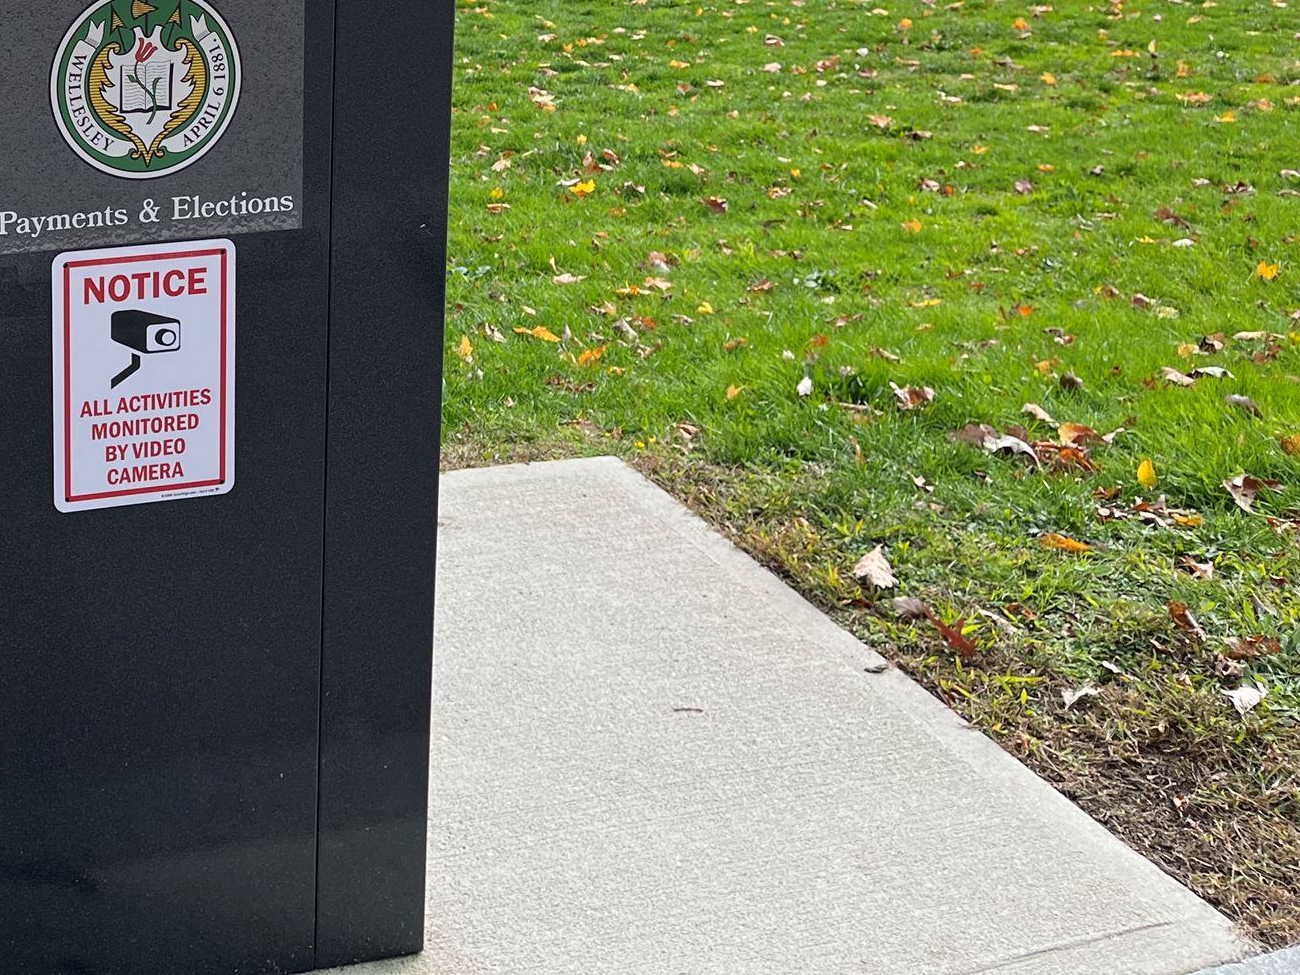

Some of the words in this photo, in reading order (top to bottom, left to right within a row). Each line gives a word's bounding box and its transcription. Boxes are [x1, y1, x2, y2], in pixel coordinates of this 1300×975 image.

[68, 54, 115, 152] WELLESLEY
[183, 101, 221, 148] APRIL
[213, 86, 225, 97] 6
[138, 198, 161, 223] &
[171, 191, 294, 221] Elections
[84, 267, 208, 305] NOTICE
[80, 399, 113, 418] ALL
[116, 388, 212, 414] ACTIVITIES
[91, 413, 200, 441] MONITORED
[105, 444, 129, 463] BY
[132, 438, 186, 459] VIDEO
[107, 461, 185, 485] CAMERA
